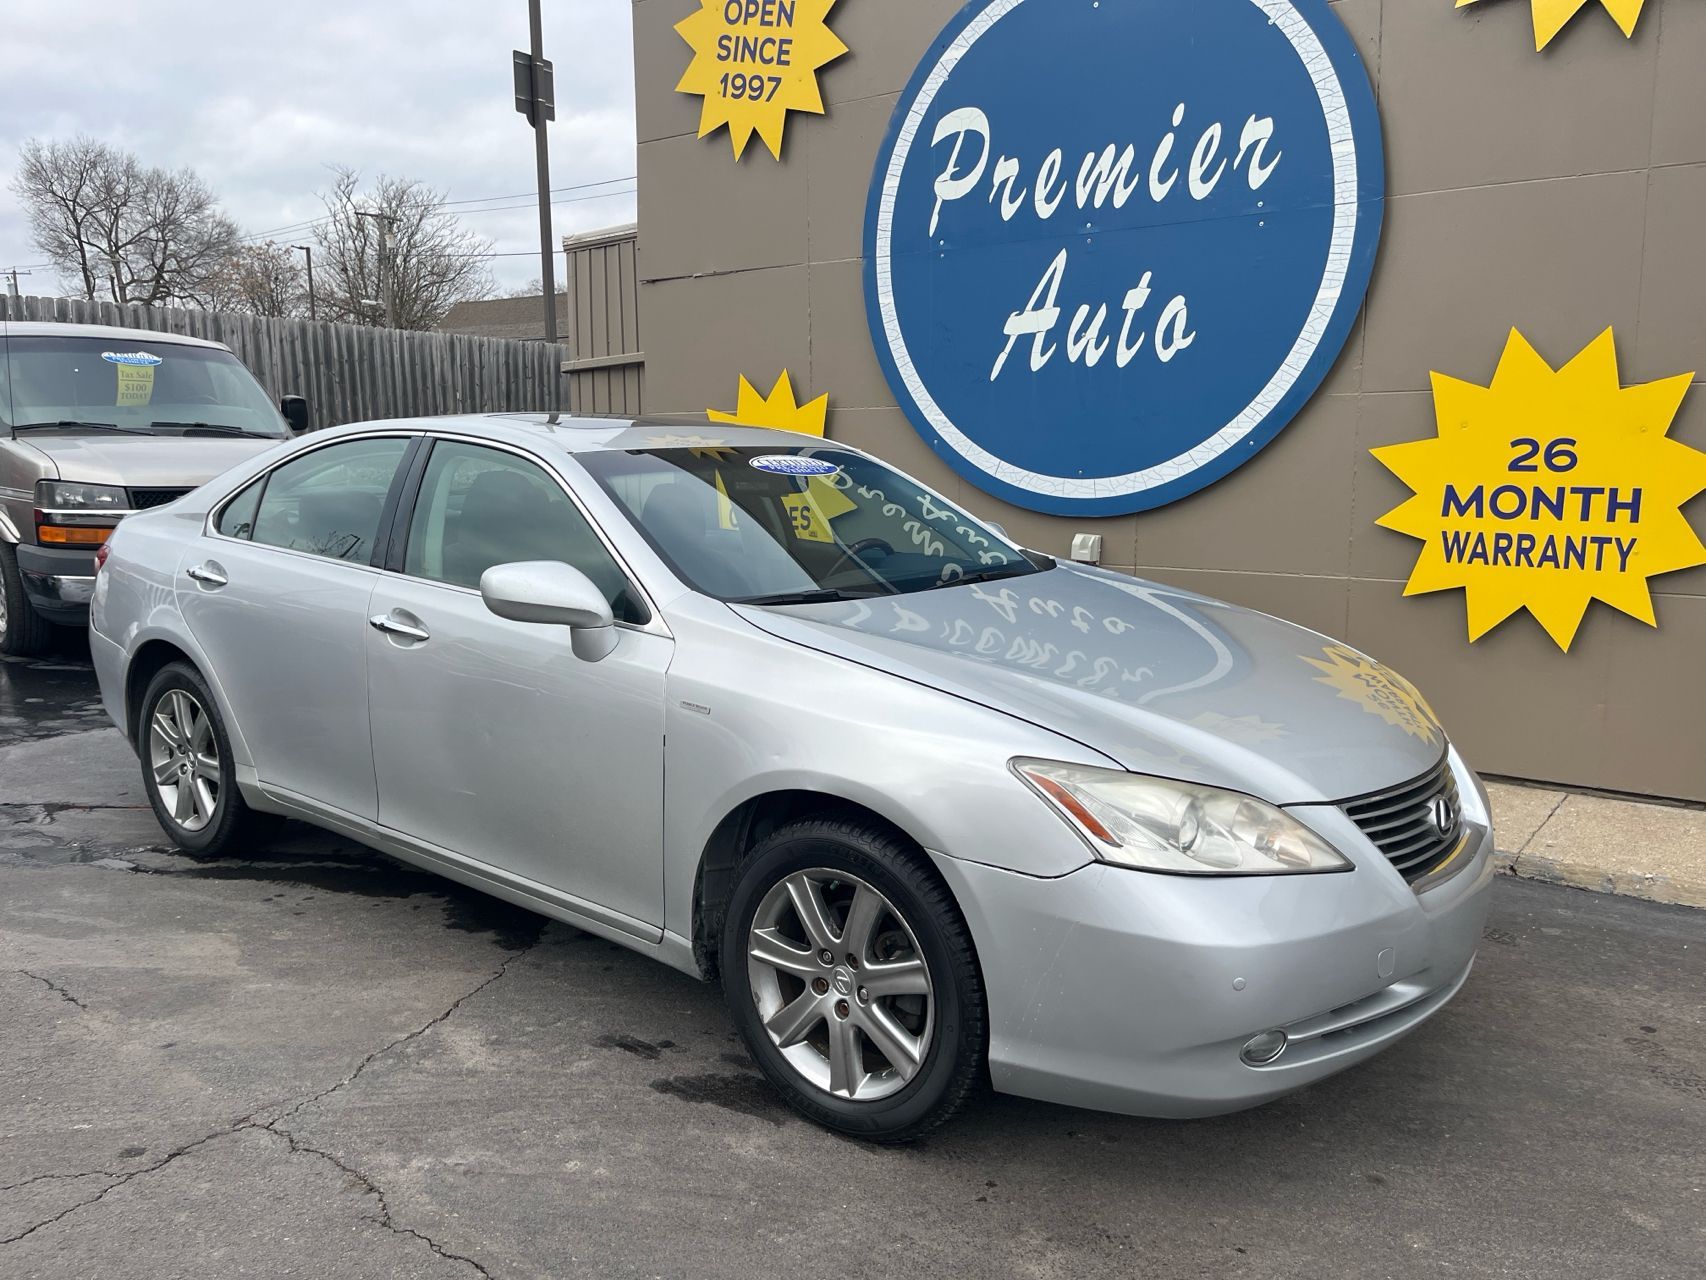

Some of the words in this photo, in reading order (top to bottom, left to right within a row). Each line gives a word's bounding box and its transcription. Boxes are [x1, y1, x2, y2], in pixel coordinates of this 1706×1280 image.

[724, 0, 796, 28] OPEN
[717, 34, 793, 66] SINCE
[720, 73, 782, 102] 1997
[930, 102, 1282, 238] Premier
[990, 247, 1196, 382] Auto
[119, 370, 134, 379] Tax
[136, 371, 153, 380] Sale
[124, 383, 147, 393] $100
[1507, 437, 1579, 473] 26
[1441, 484, 1643, 523] MONTH
[1441, 531, 1637, 572] WARRANTY
